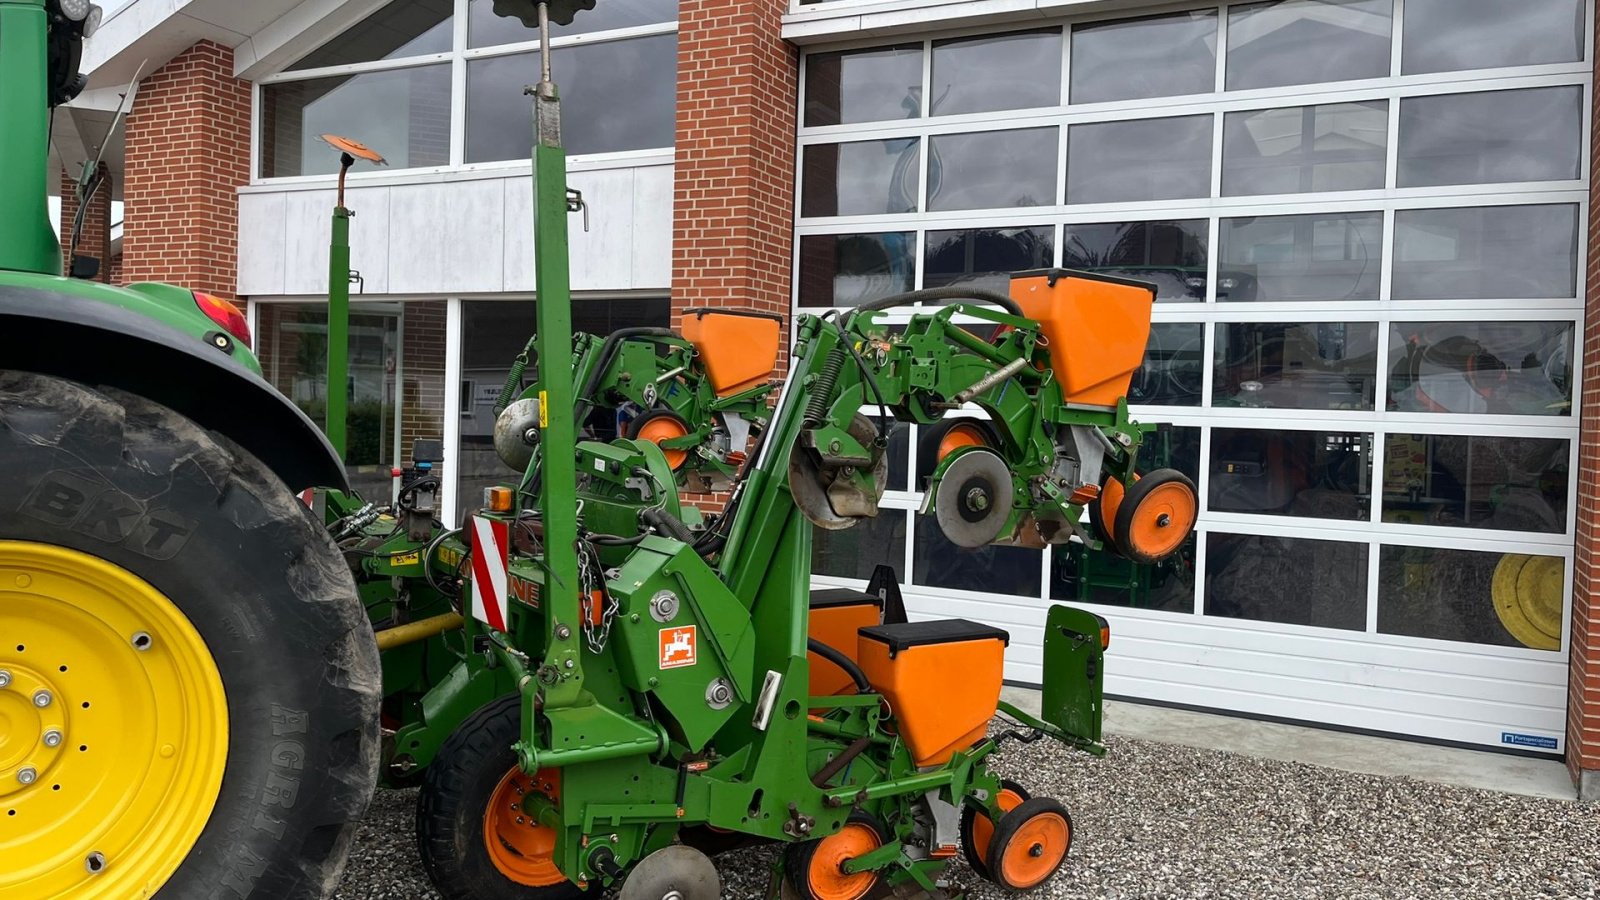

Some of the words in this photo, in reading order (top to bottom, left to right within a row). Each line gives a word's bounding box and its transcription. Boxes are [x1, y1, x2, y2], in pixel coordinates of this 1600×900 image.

[33, 479, 188, 551] BKT
[508, 571, 540, 609] NE
[208, 842, 271, 900] M
